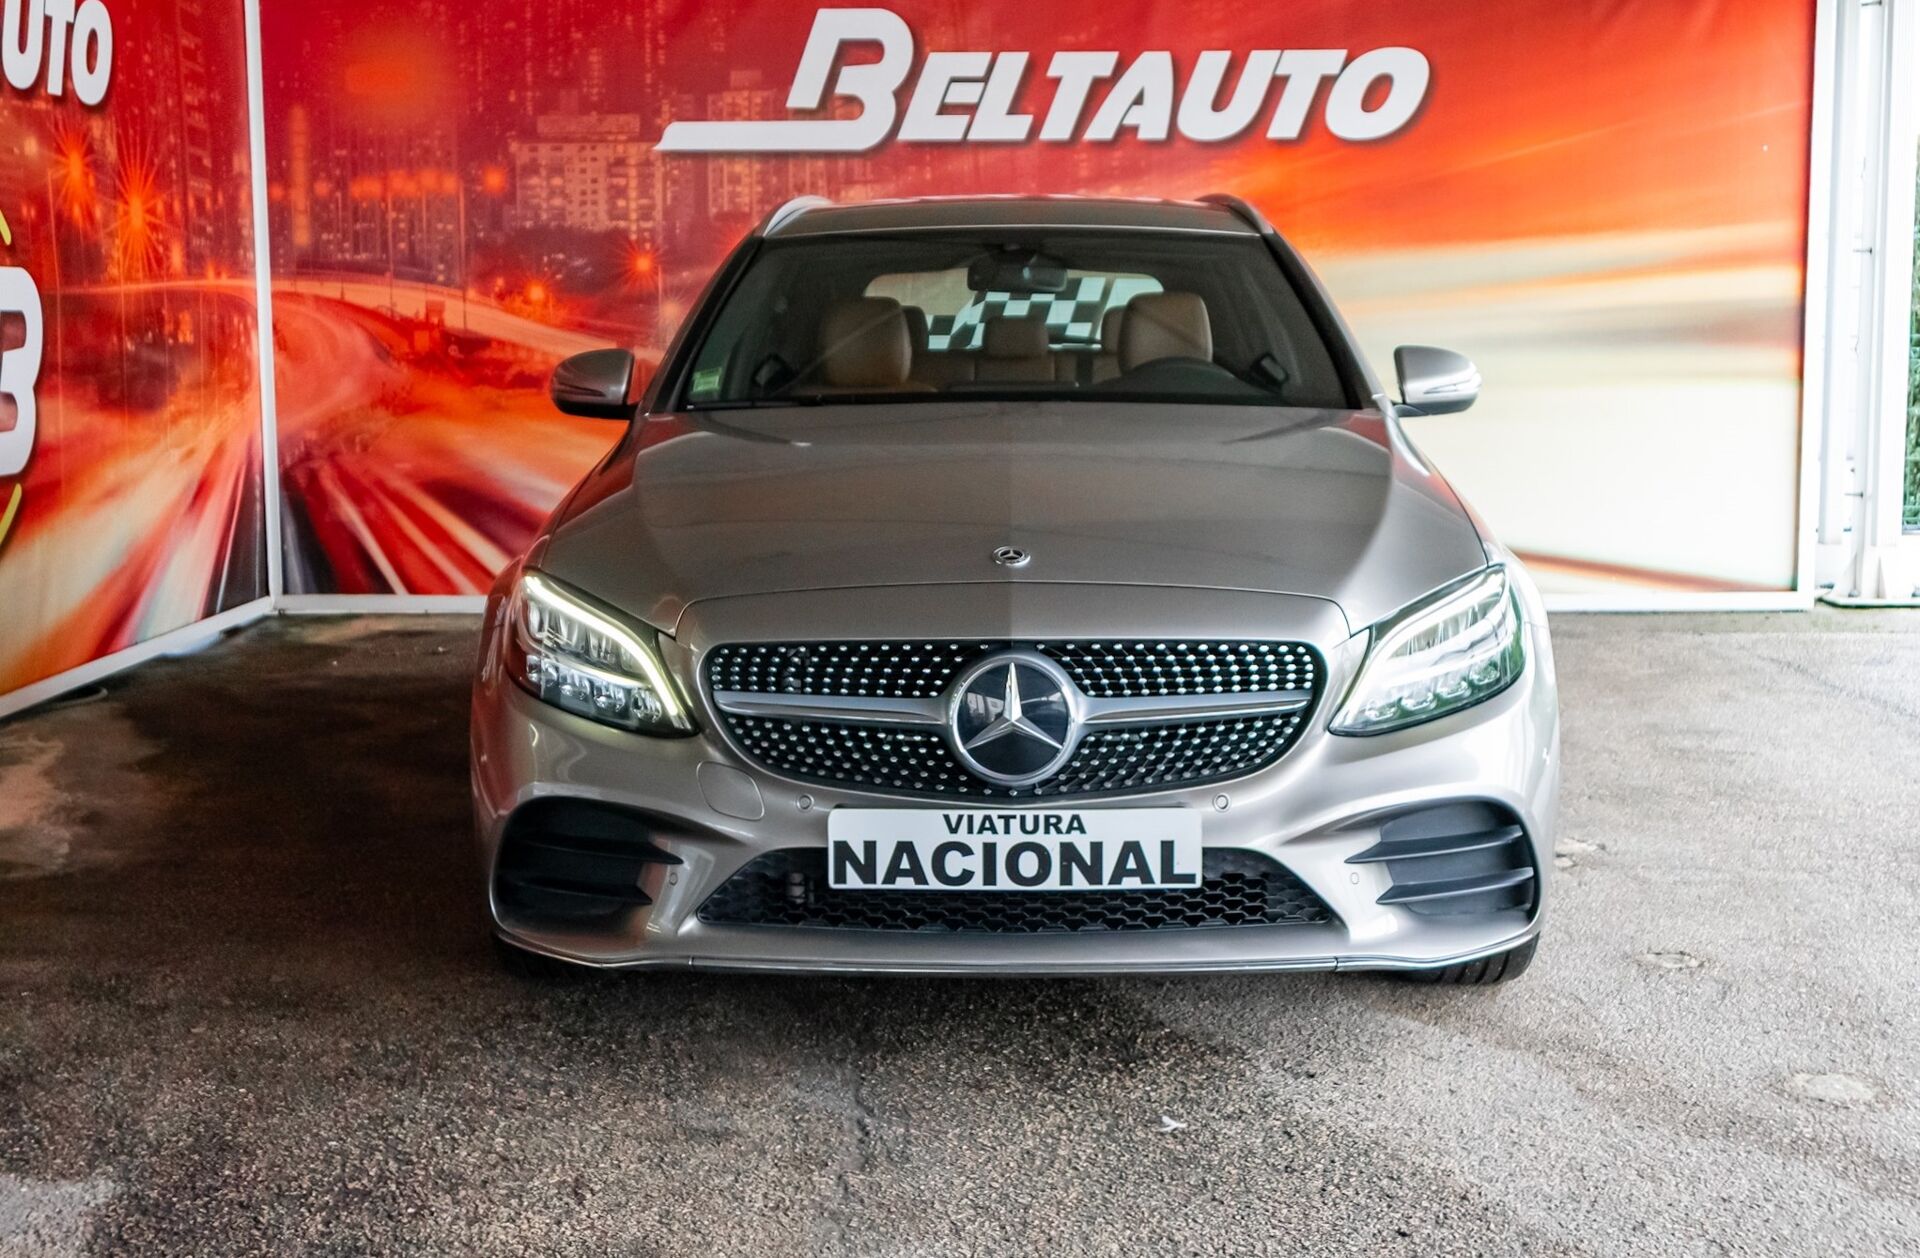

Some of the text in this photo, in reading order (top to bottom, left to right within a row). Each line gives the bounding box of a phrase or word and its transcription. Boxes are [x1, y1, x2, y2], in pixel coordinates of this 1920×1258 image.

[652, 8, 1430, 150] BELTAUTO
[943, 813, 1087, 835] VIATURA
[833, 840, 1197, 886] NACIONAL
